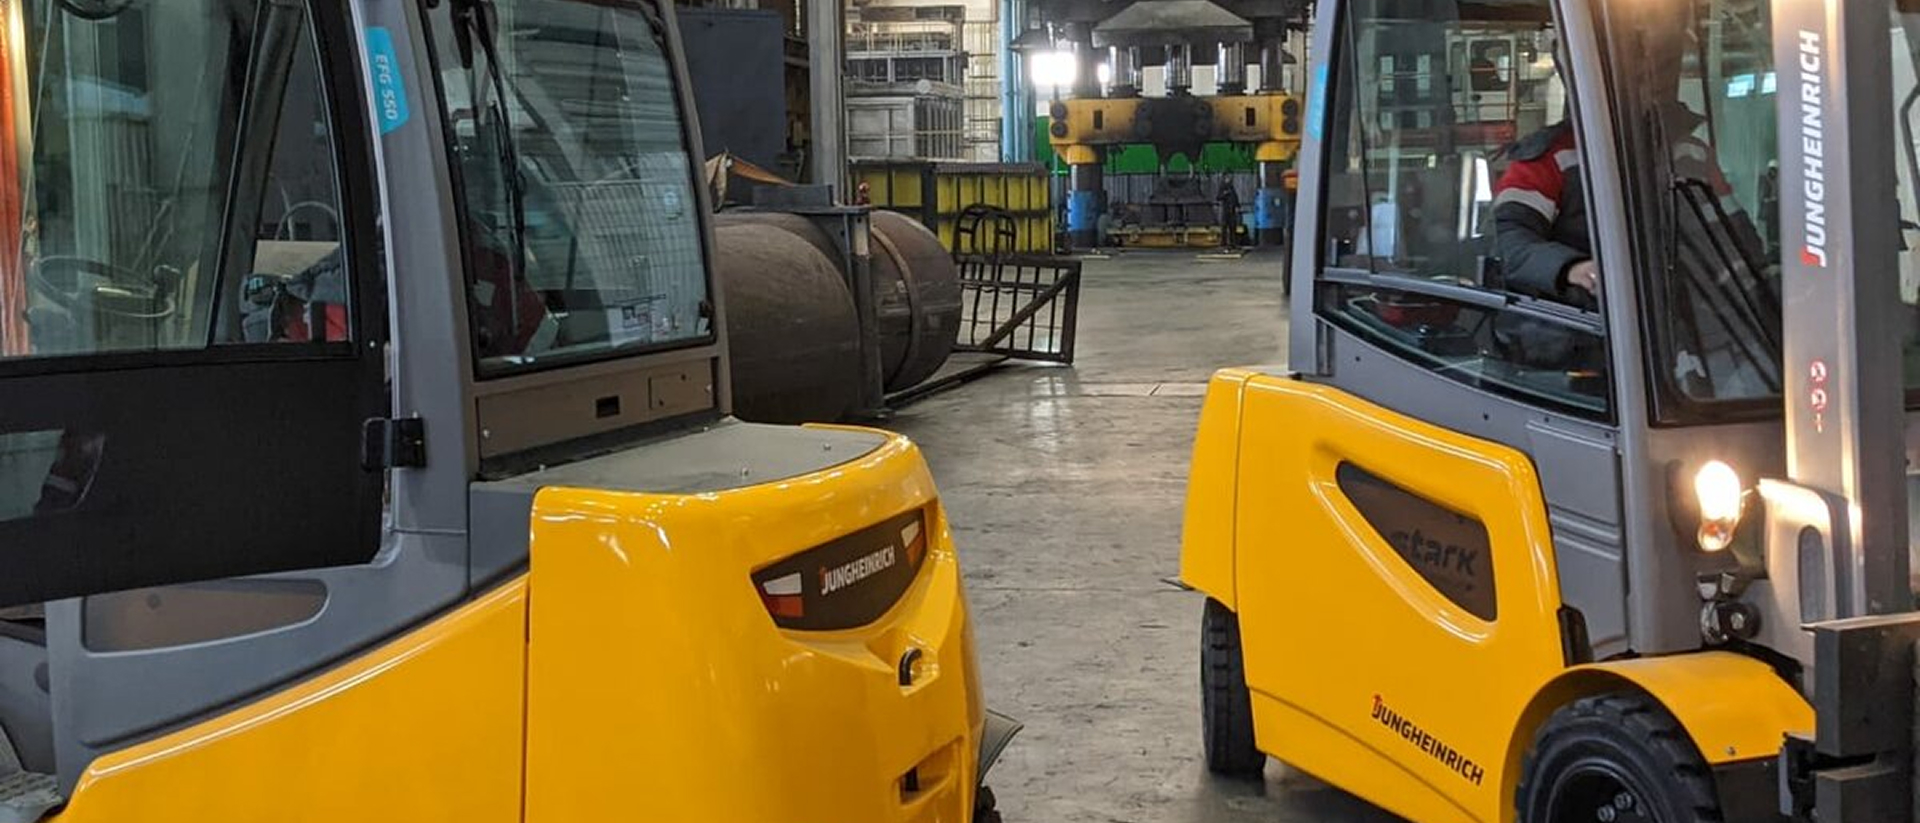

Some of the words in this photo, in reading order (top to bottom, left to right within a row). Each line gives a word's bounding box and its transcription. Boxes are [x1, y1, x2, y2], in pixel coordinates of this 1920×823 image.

[375, 54, 393, 86] EFG
[1799, 30, 1827, 268] JUNGHEINRICH
[820, 545, 896, 596] JUNGHEINRICH
[1371, 694, 1484, 786] JUNGHEINRICH
